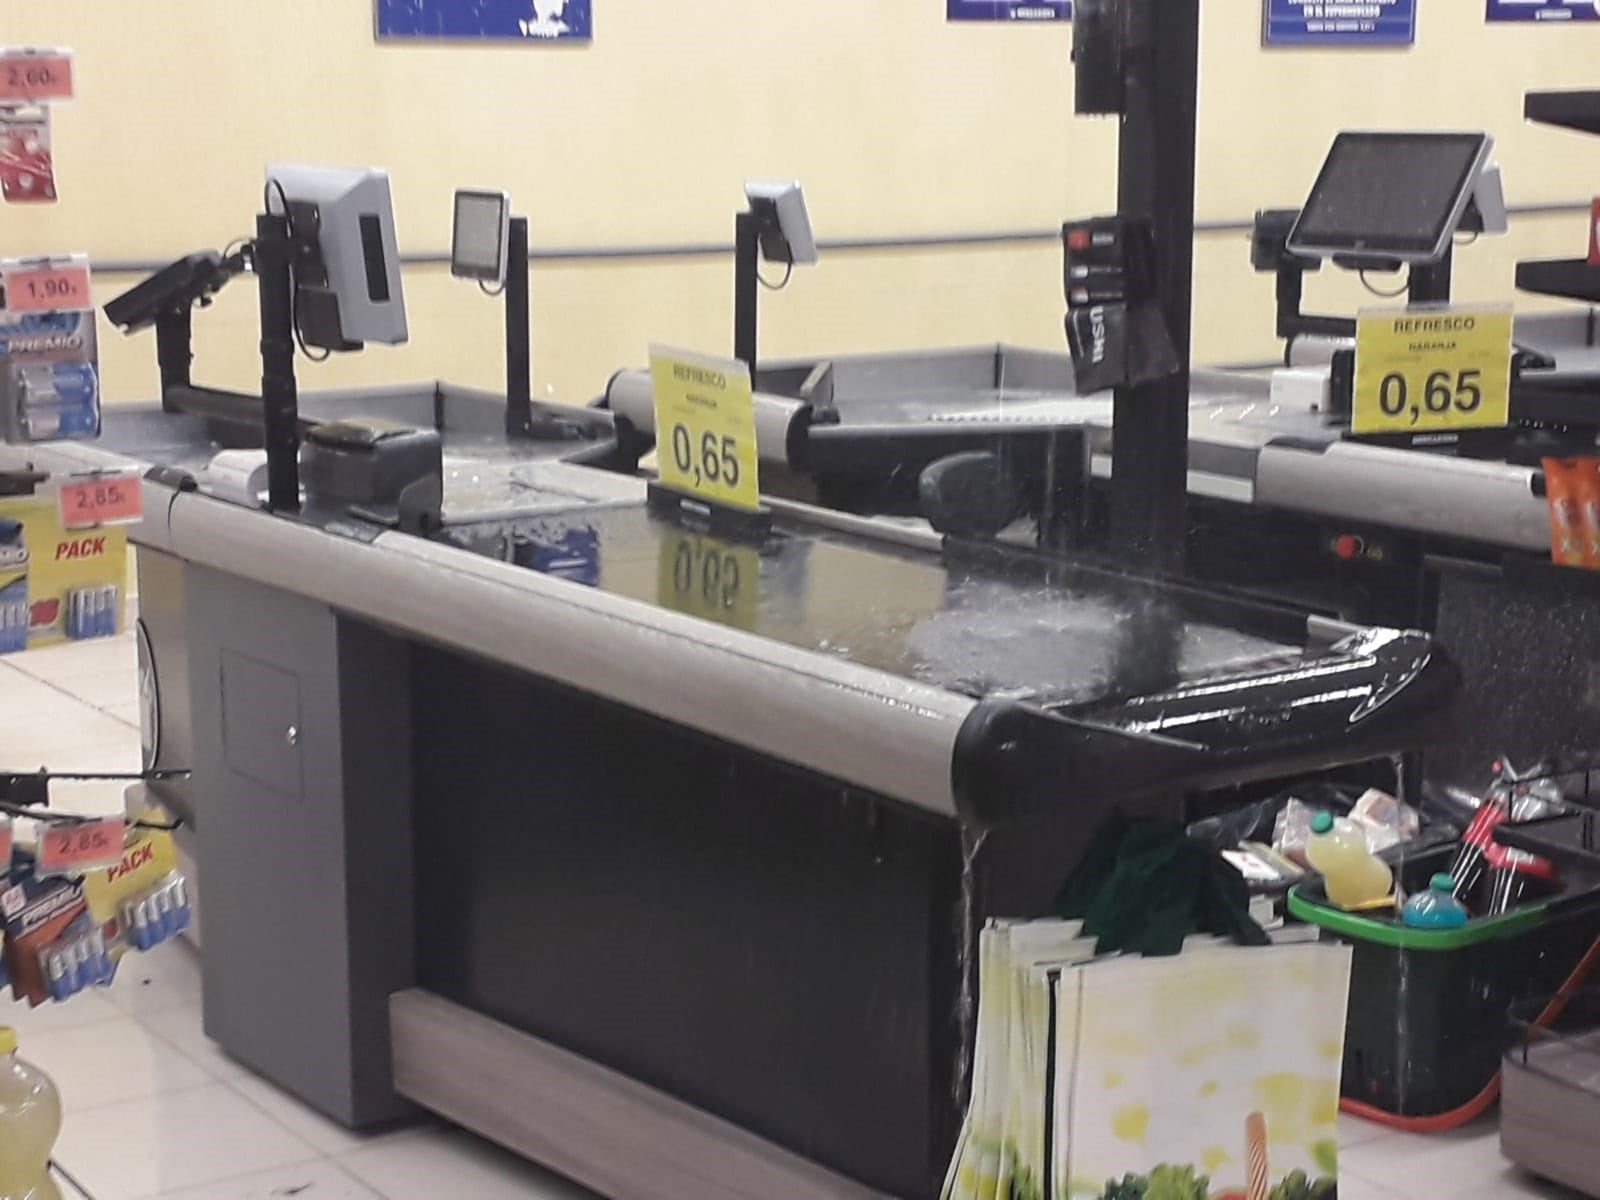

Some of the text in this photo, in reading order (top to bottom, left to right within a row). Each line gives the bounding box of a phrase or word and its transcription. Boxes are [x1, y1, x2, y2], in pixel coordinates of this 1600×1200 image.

[1393, 316, 1475, 334] REFRESCO
[1379, 368, 1482, 426] 0,65
[672, 422, 740, 488] 0,65
[55, 536, 106, 560] PACK
